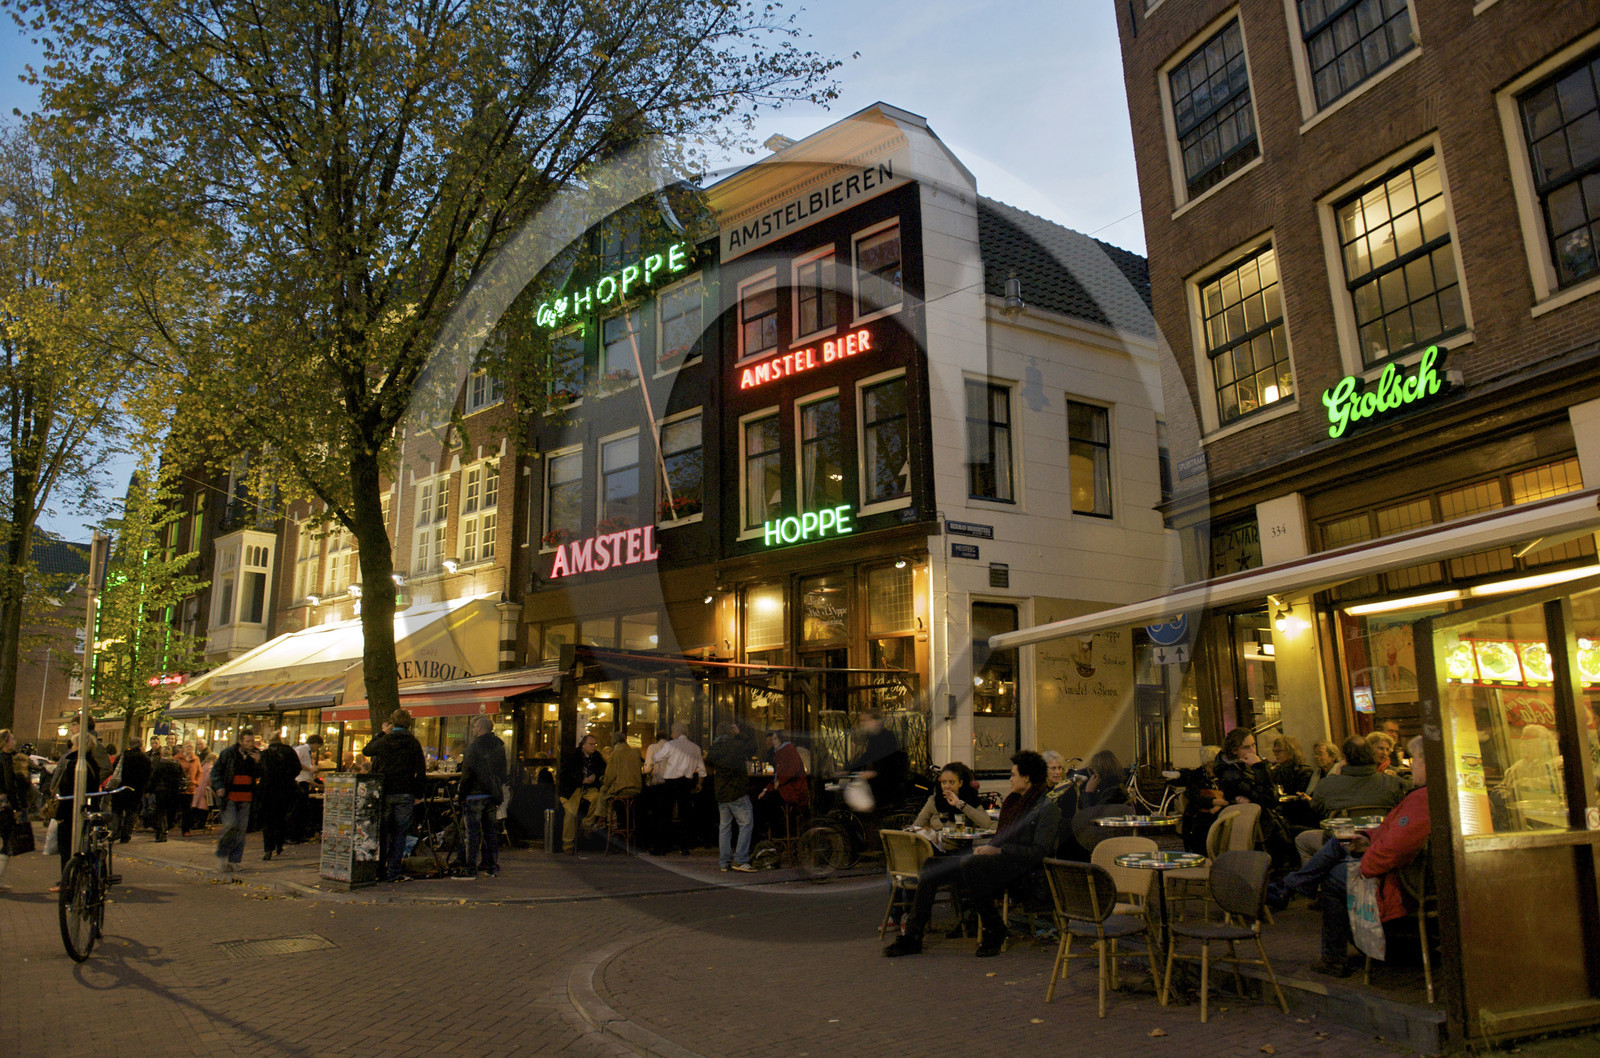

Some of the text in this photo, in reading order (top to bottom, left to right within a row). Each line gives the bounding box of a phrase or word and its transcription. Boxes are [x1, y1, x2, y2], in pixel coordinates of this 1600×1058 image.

[729, 159, 893, 251] AMSTELBIEREN
[574, 243, 686, 315] HOPPE
[740, 329, 871, 390] AMSTEL BIER
[1321, 344, 1442, 439] Grolsch
[549, 525, 659, 579] AMSTEL
[764, 504, 853, 546] HOPPE
[1271, 523, 1287, 538] 334
